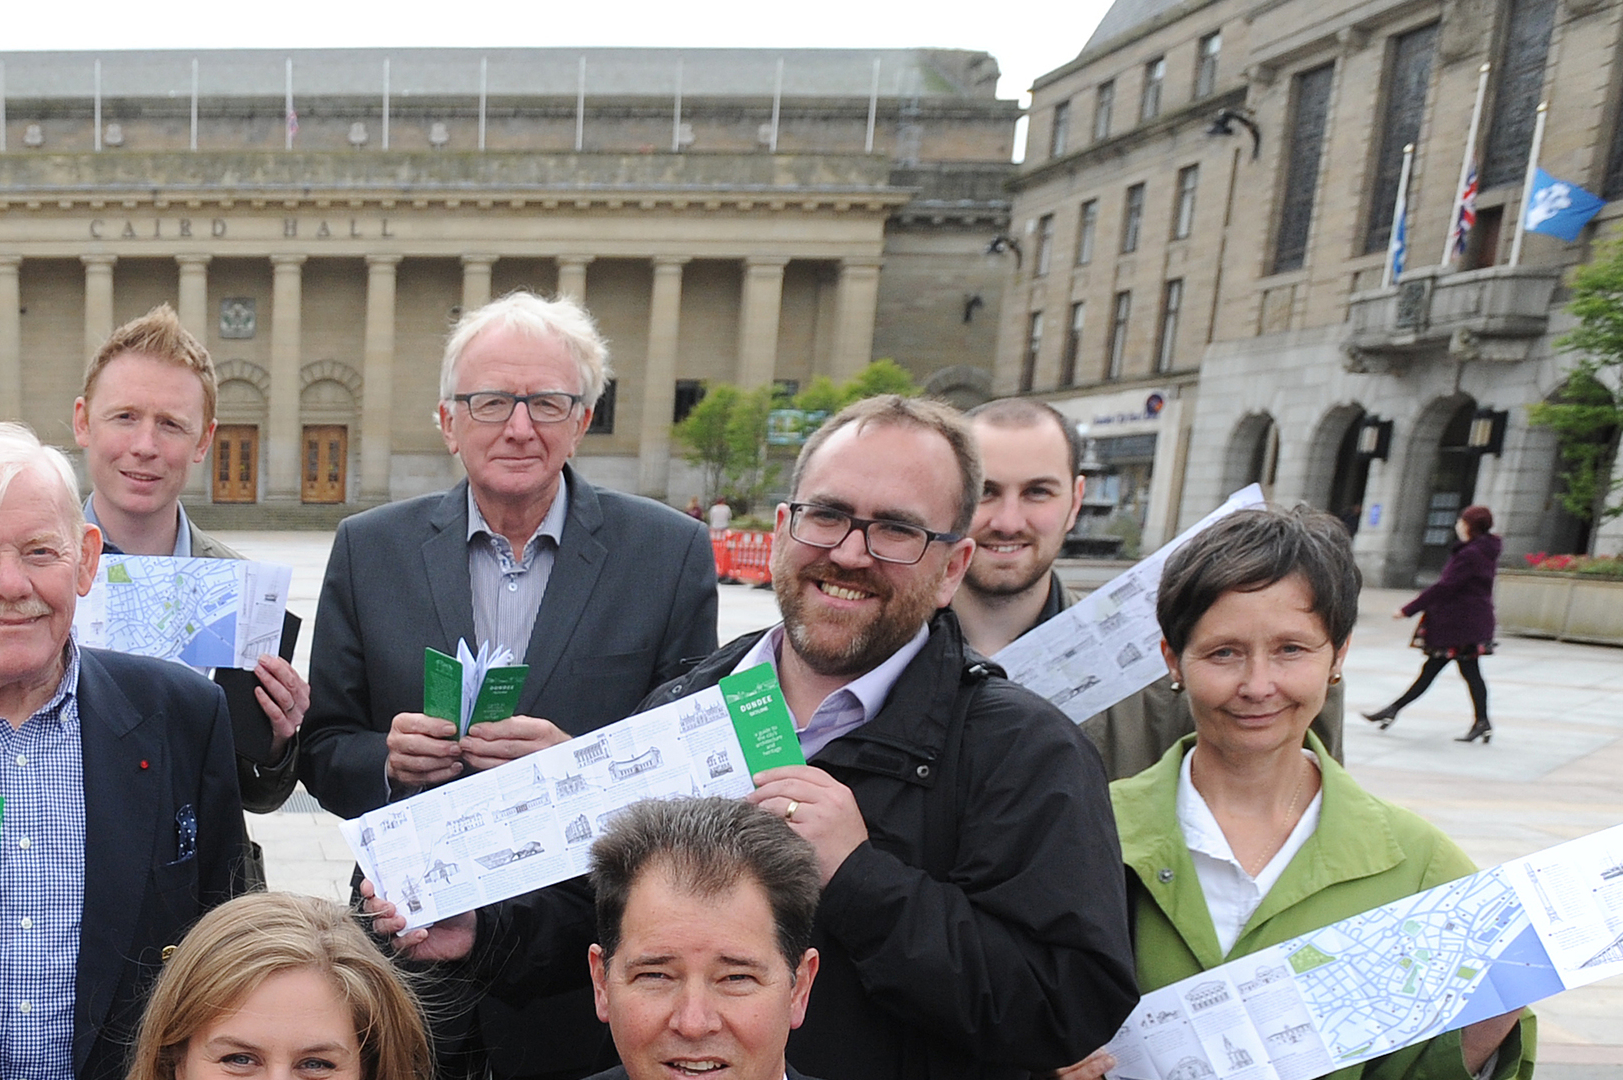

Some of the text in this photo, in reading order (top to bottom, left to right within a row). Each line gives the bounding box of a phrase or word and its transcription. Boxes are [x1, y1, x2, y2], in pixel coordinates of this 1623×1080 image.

[89, 218, 396, 239] CAIRD HALL
[740, 695, 773, 713] DUNDEE
